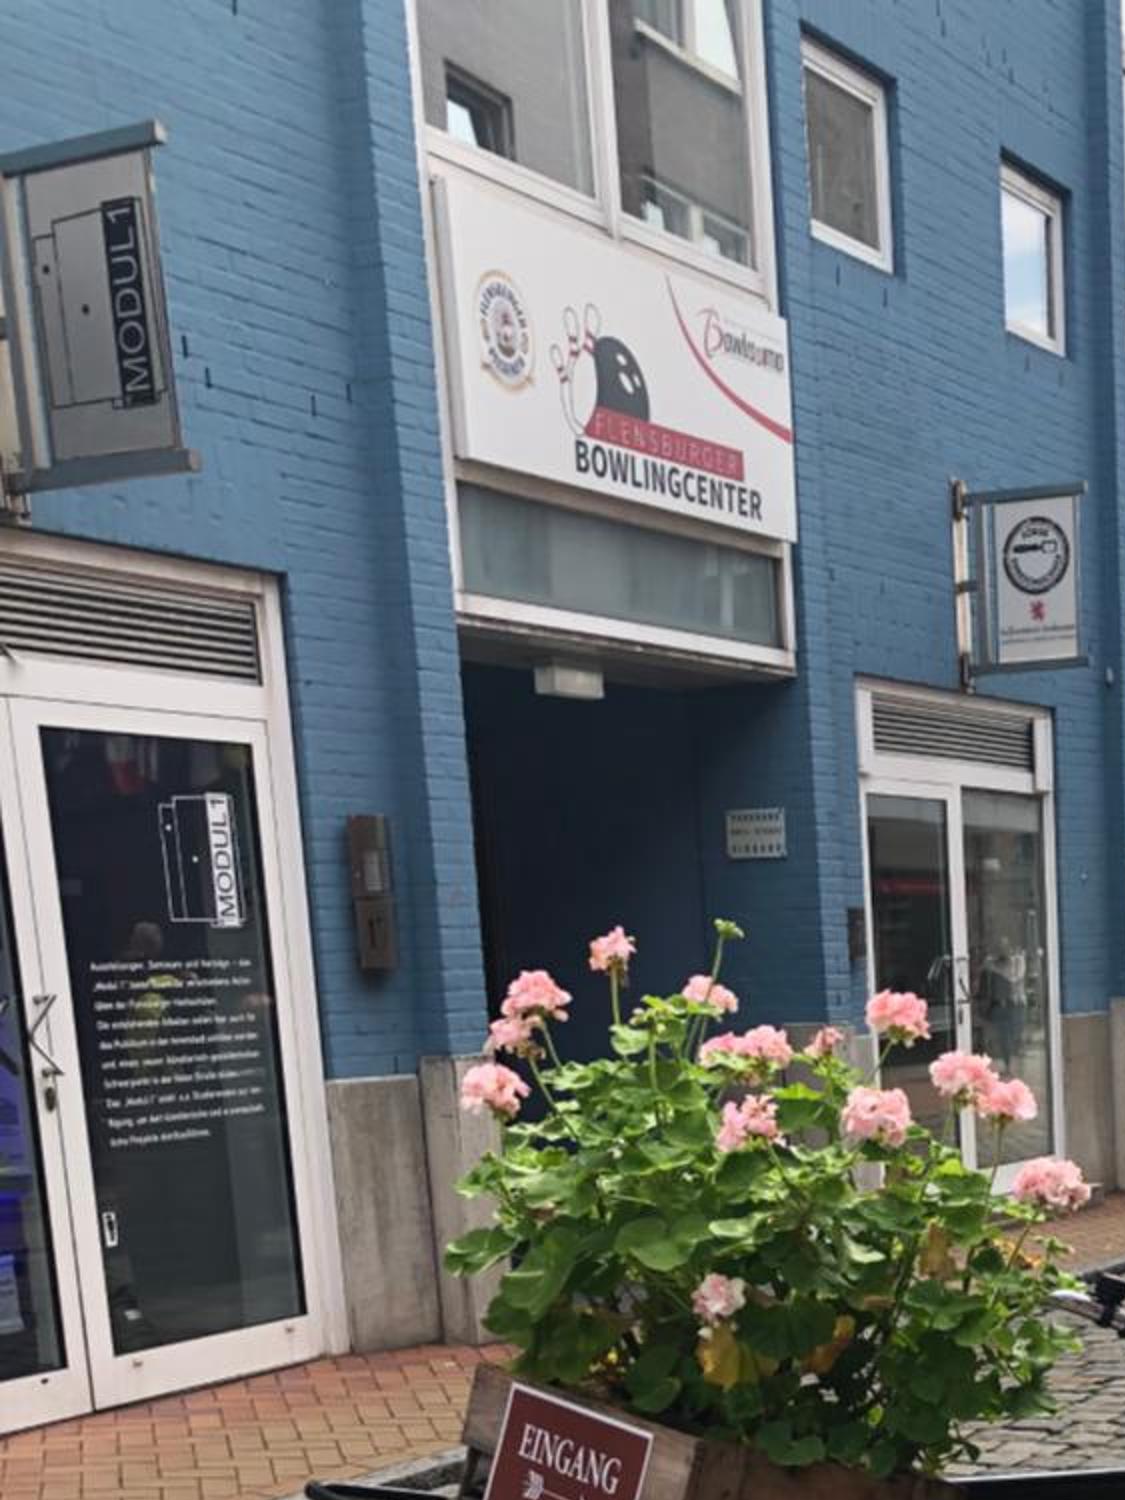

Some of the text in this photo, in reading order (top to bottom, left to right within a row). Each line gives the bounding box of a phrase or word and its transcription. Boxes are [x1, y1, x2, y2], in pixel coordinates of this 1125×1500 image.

[594, 411, 739, 475] FLENSBURGER
[575, 440, 763, 521] BOWLINGCENTER
[518, 1423, 623, 1495] EINGANG
